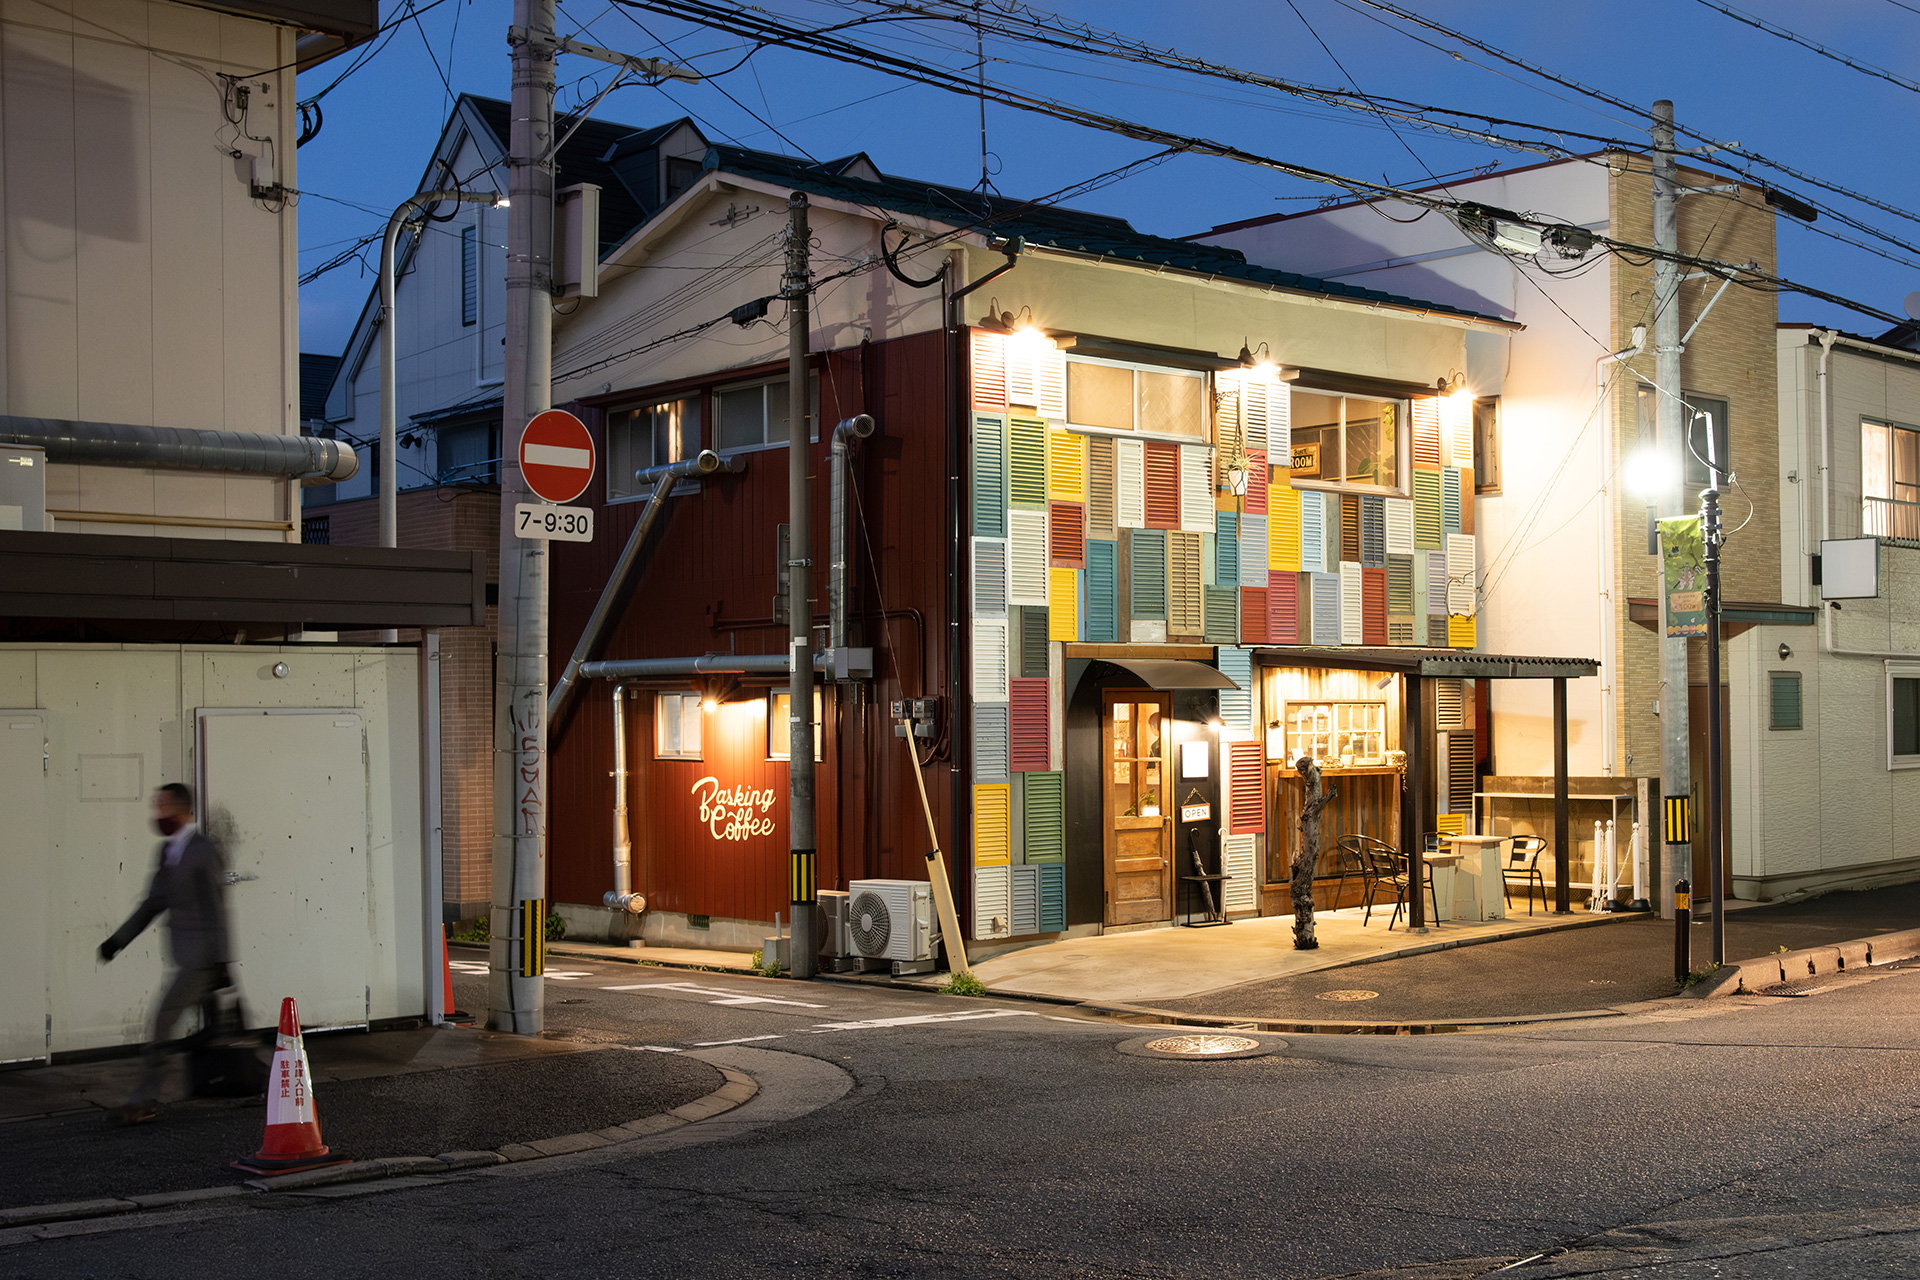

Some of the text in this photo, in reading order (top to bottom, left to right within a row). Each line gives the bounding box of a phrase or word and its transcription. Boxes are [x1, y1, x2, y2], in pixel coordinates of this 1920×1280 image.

[519, 511, 588, 534] 7-9:30
[691, 776, 776, 822] Basking
[1184, 808, 1207, 818] OPEN
[710, 805, 776, 841] Coffee
[280, 1059, 290, 1098] 駐車禁止
[294, 1059, 304, 1107] 倉庫入口前
